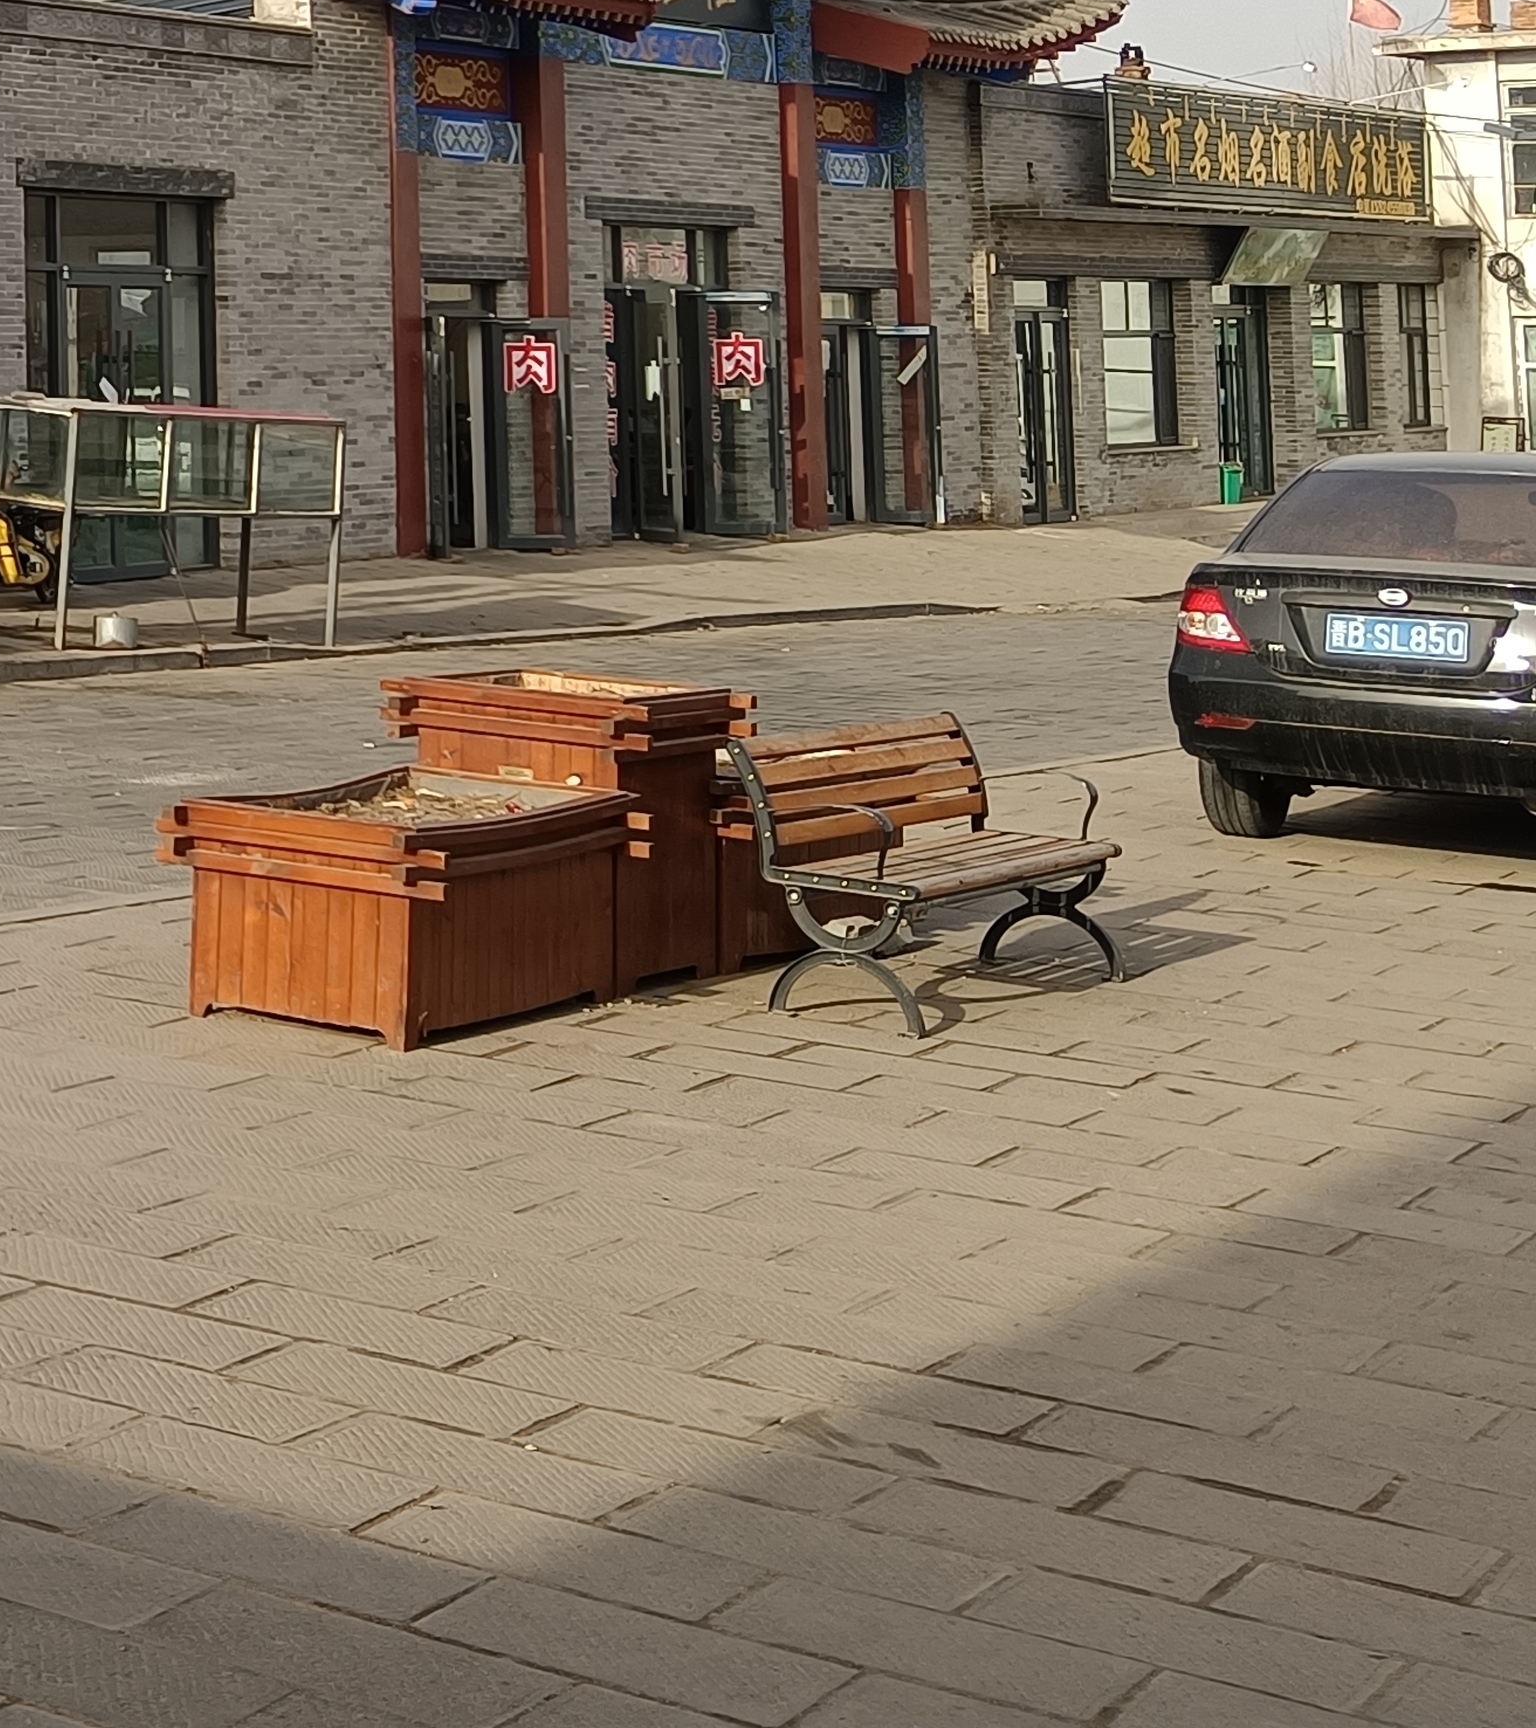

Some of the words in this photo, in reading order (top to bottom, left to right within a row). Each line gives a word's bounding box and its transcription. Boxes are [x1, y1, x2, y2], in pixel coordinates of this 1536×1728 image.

[503, 335, 556, 393] 肉
[712, 332, 765, 387] 肉
[1330, 620, 1465, 656] 晋B·SL850
